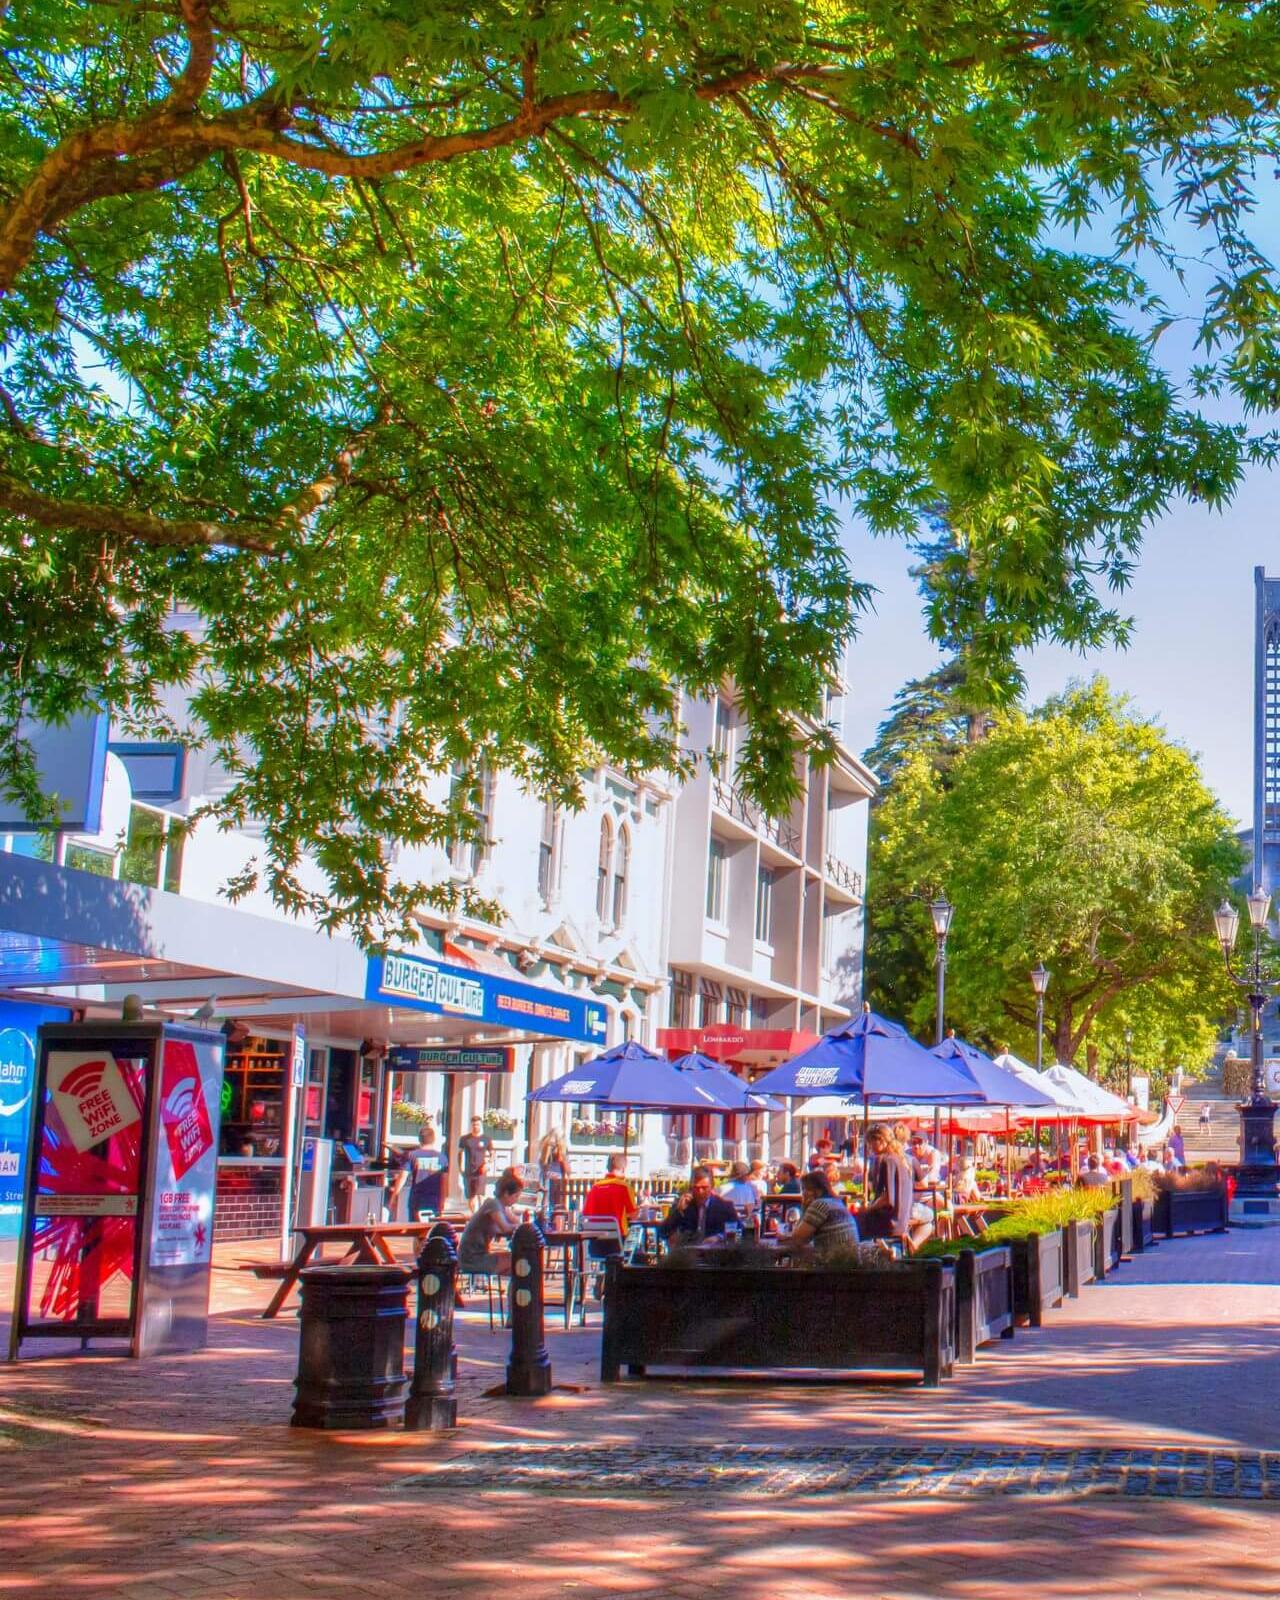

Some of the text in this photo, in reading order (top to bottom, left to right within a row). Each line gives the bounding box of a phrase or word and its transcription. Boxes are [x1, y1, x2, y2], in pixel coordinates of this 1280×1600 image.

[385, 959, 434, 999] BURGER
[439, 976, 483, 1011] CULTURE
[78, 1089, 111, 1115] FREE
[90, 1114, 121, 1138] ZONE
[175, 1109, 199, 1137] FREE
[0, 1161, 17, 1172] AN
[174, 1192, 190, 1204] FREE
